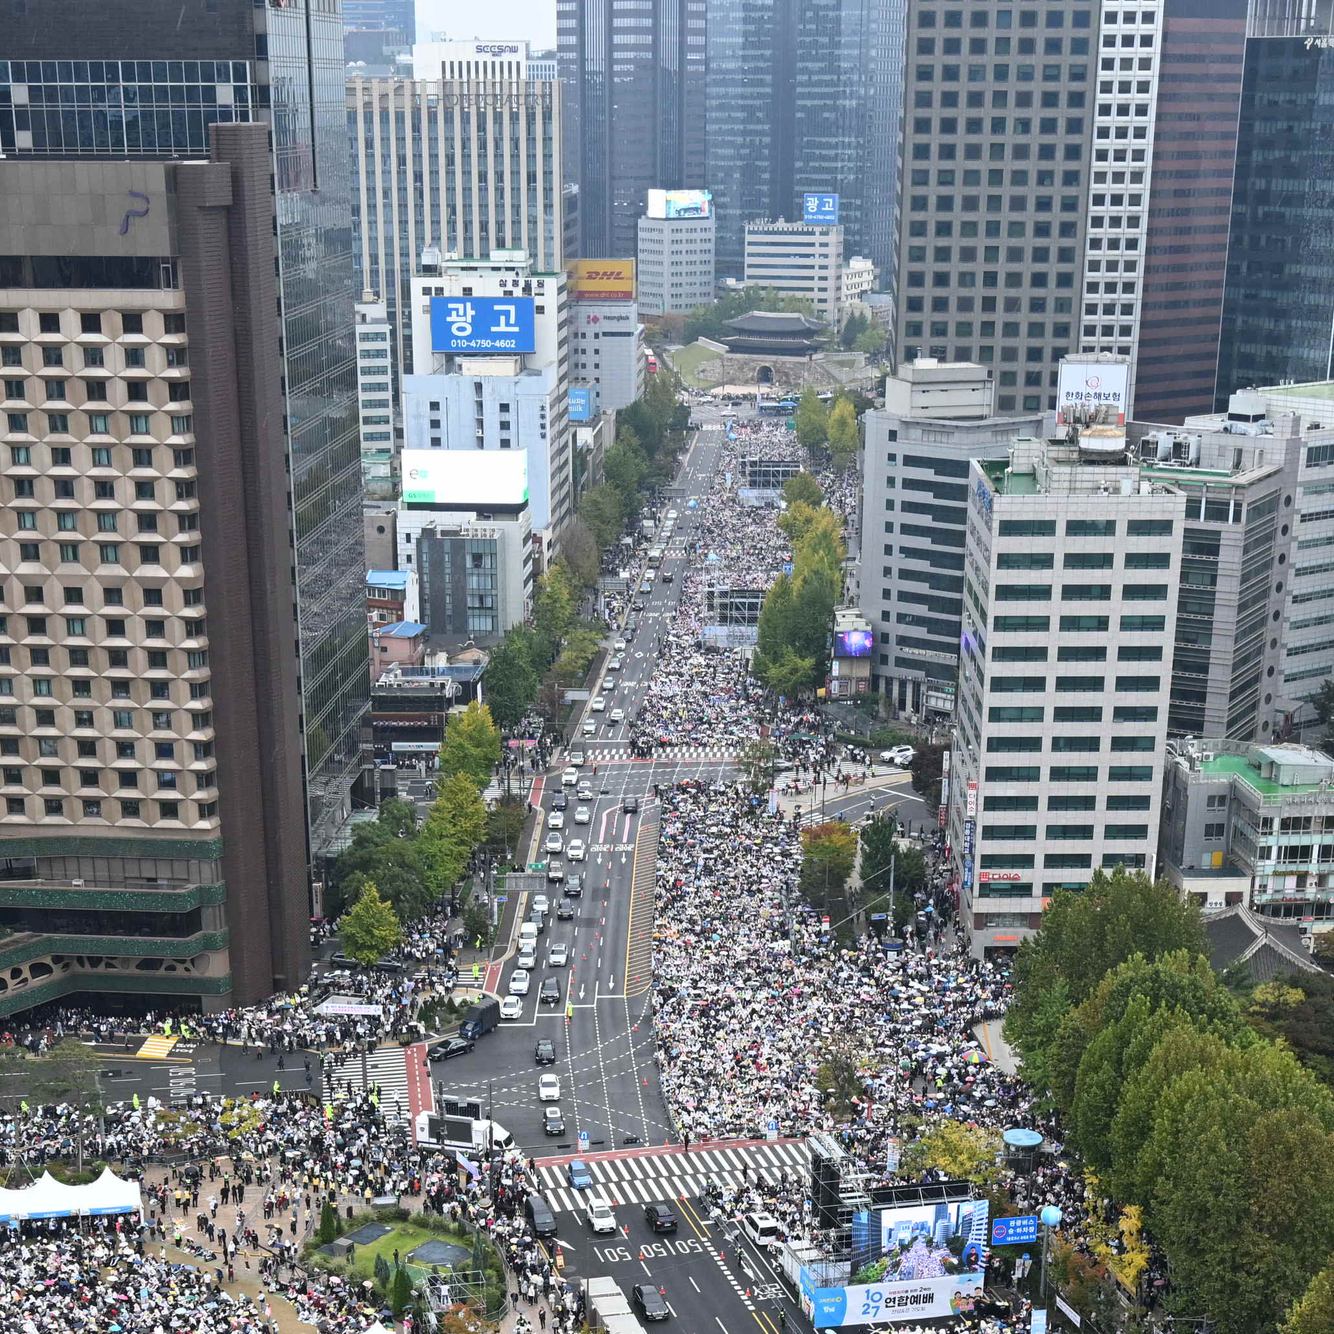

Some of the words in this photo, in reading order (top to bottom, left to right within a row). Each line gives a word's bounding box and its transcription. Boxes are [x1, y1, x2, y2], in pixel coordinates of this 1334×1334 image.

[806, 197, 834, 212] 광고
[585, 271, 625, 280] DHL
[583, 291, 625, 299] www.dhl.co.kr
[446, 302, 519, 337] 광고
[603, 314, 630, 322] Heungkuk
[451, 339, 516, 348] 010-4750-4602
[1065, 391, 1121, 401] 한화손해보험
[992, 872, 1021, 881] 다이소
[606, 1247, 632, 1262] 50
[639, 1244, 667, 1258] 50
[675, 1239, 703, 1254] 50
[865, 1288, 883, 1303] 10
[884, 1292, 934, 1309] 연합예배
[861, 1303, 880, 1318] 27
